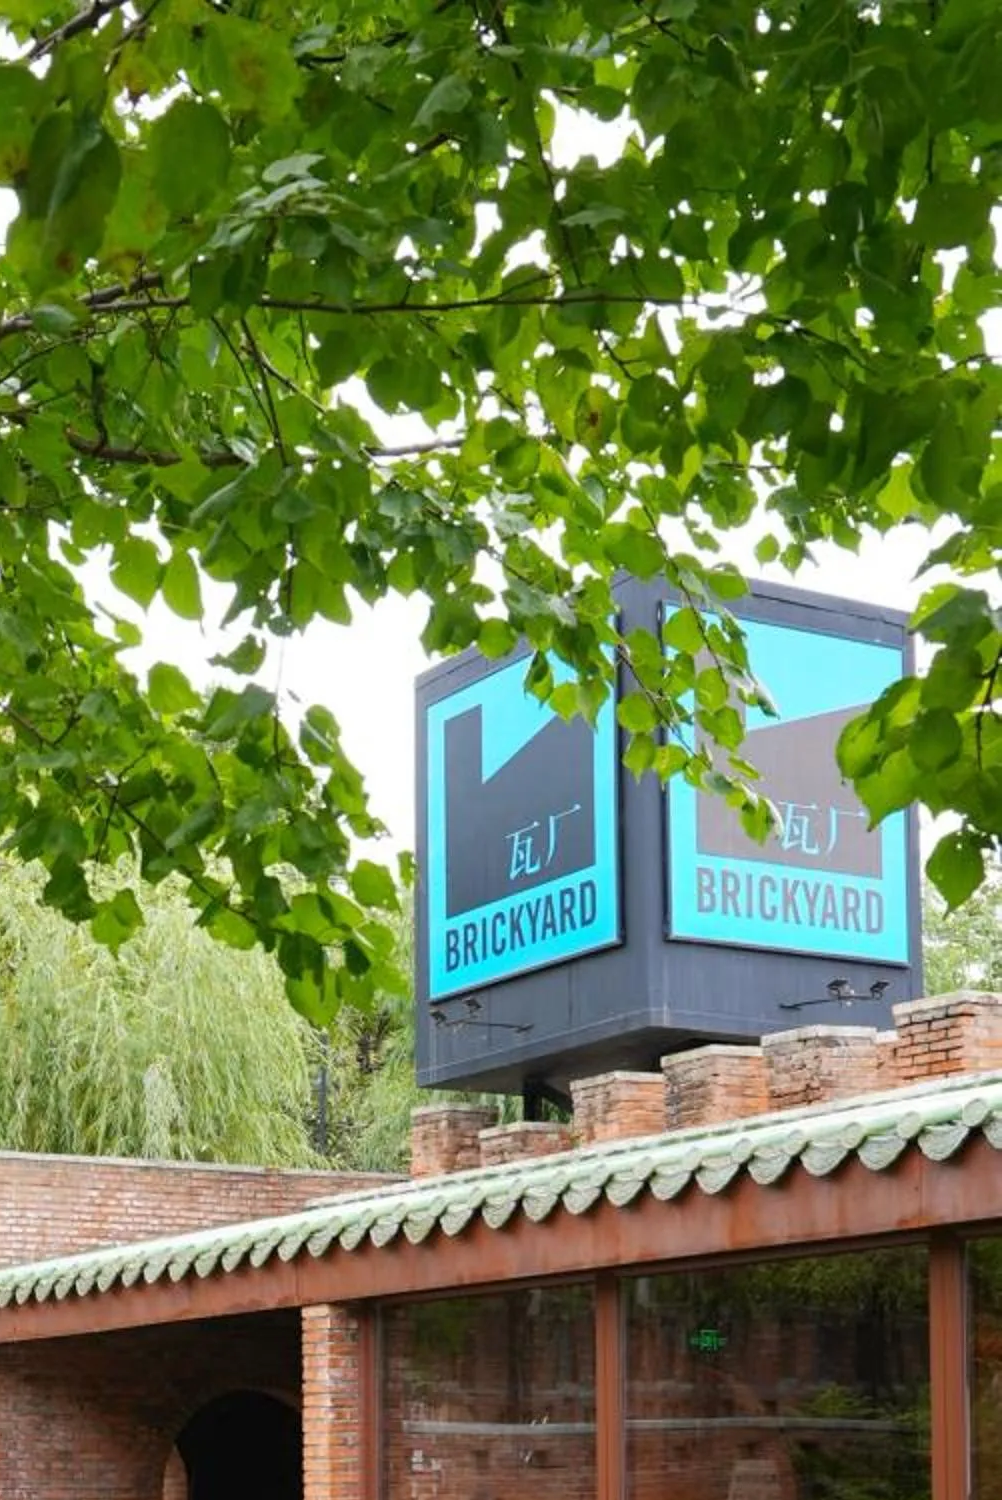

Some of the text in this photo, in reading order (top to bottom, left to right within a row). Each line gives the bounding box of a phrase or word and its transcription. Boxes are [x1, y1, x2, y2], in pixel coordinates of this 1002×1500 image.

[505, 803, 581, 880] 瓦厂
[778, 799, 866, 863] 瓦厂
[445, 878, 597, 973] BRICKYARD
[696, 866, 883, 935] BRICKYARD
